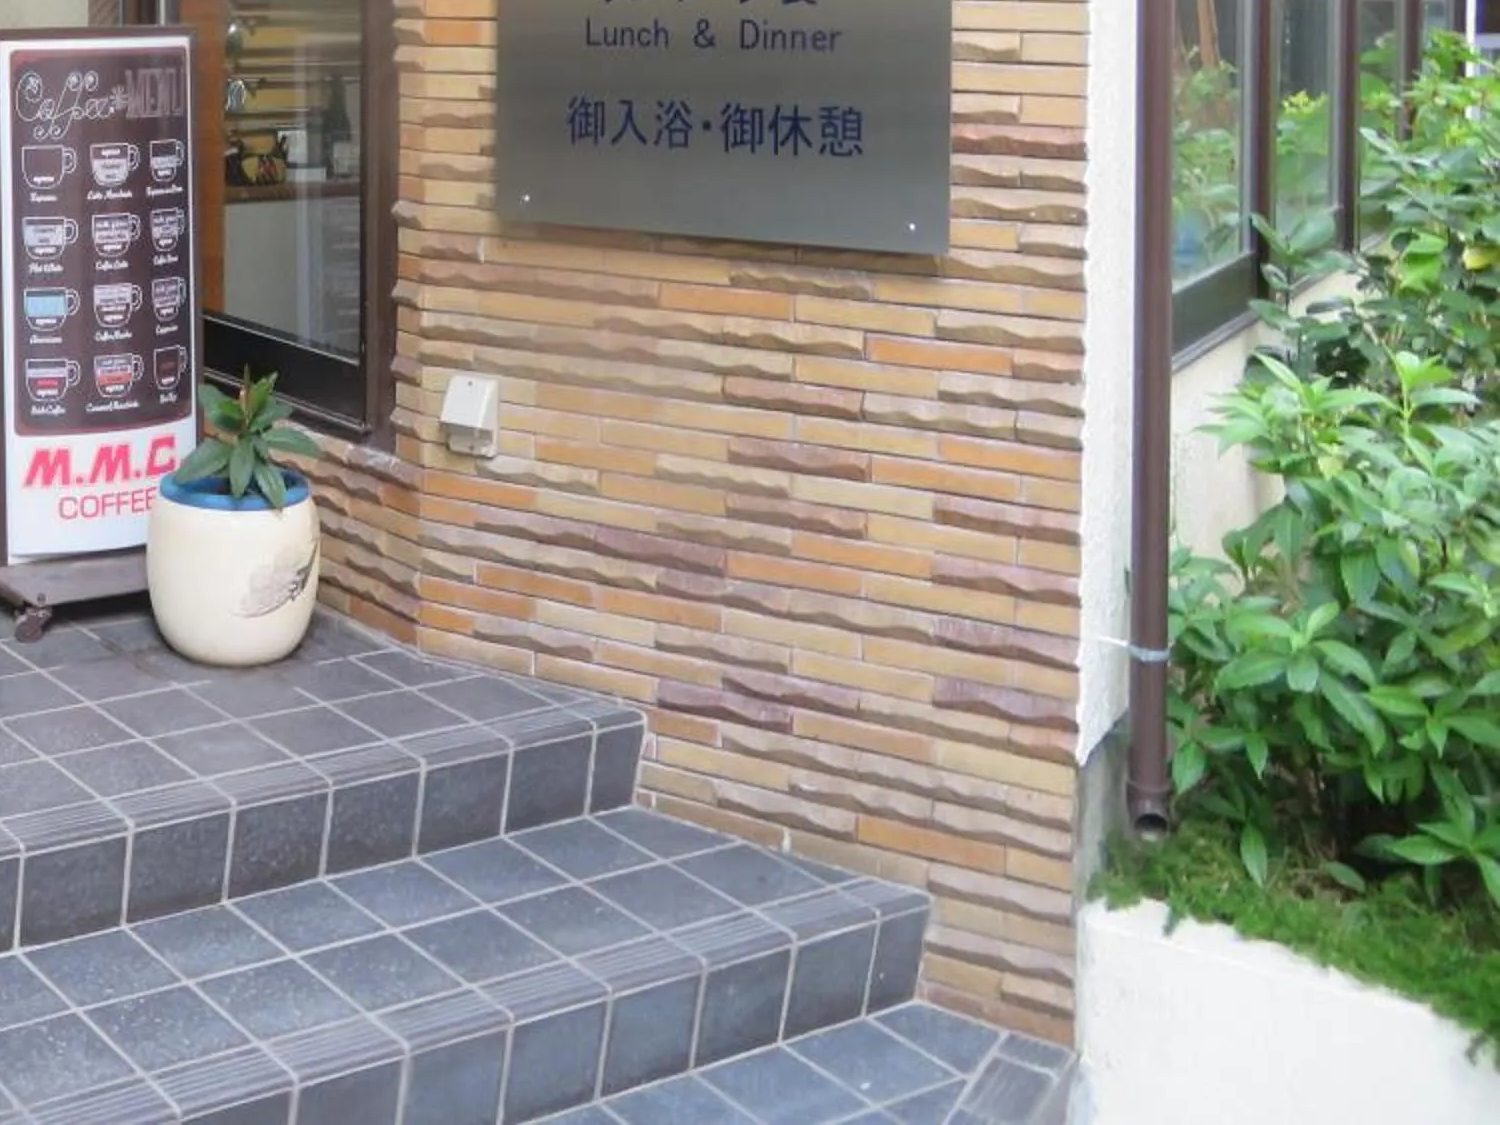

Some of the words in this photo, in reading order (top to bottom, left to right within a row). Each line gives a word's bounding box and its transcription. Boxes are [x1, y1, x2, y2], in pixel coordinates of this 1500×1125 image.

[585, 18, 670, 48] Lunch
[693, 18, 717, 50] &
[740, 19, 843, 53] Dinner
[58, 486, 157, 520] COFFEE
